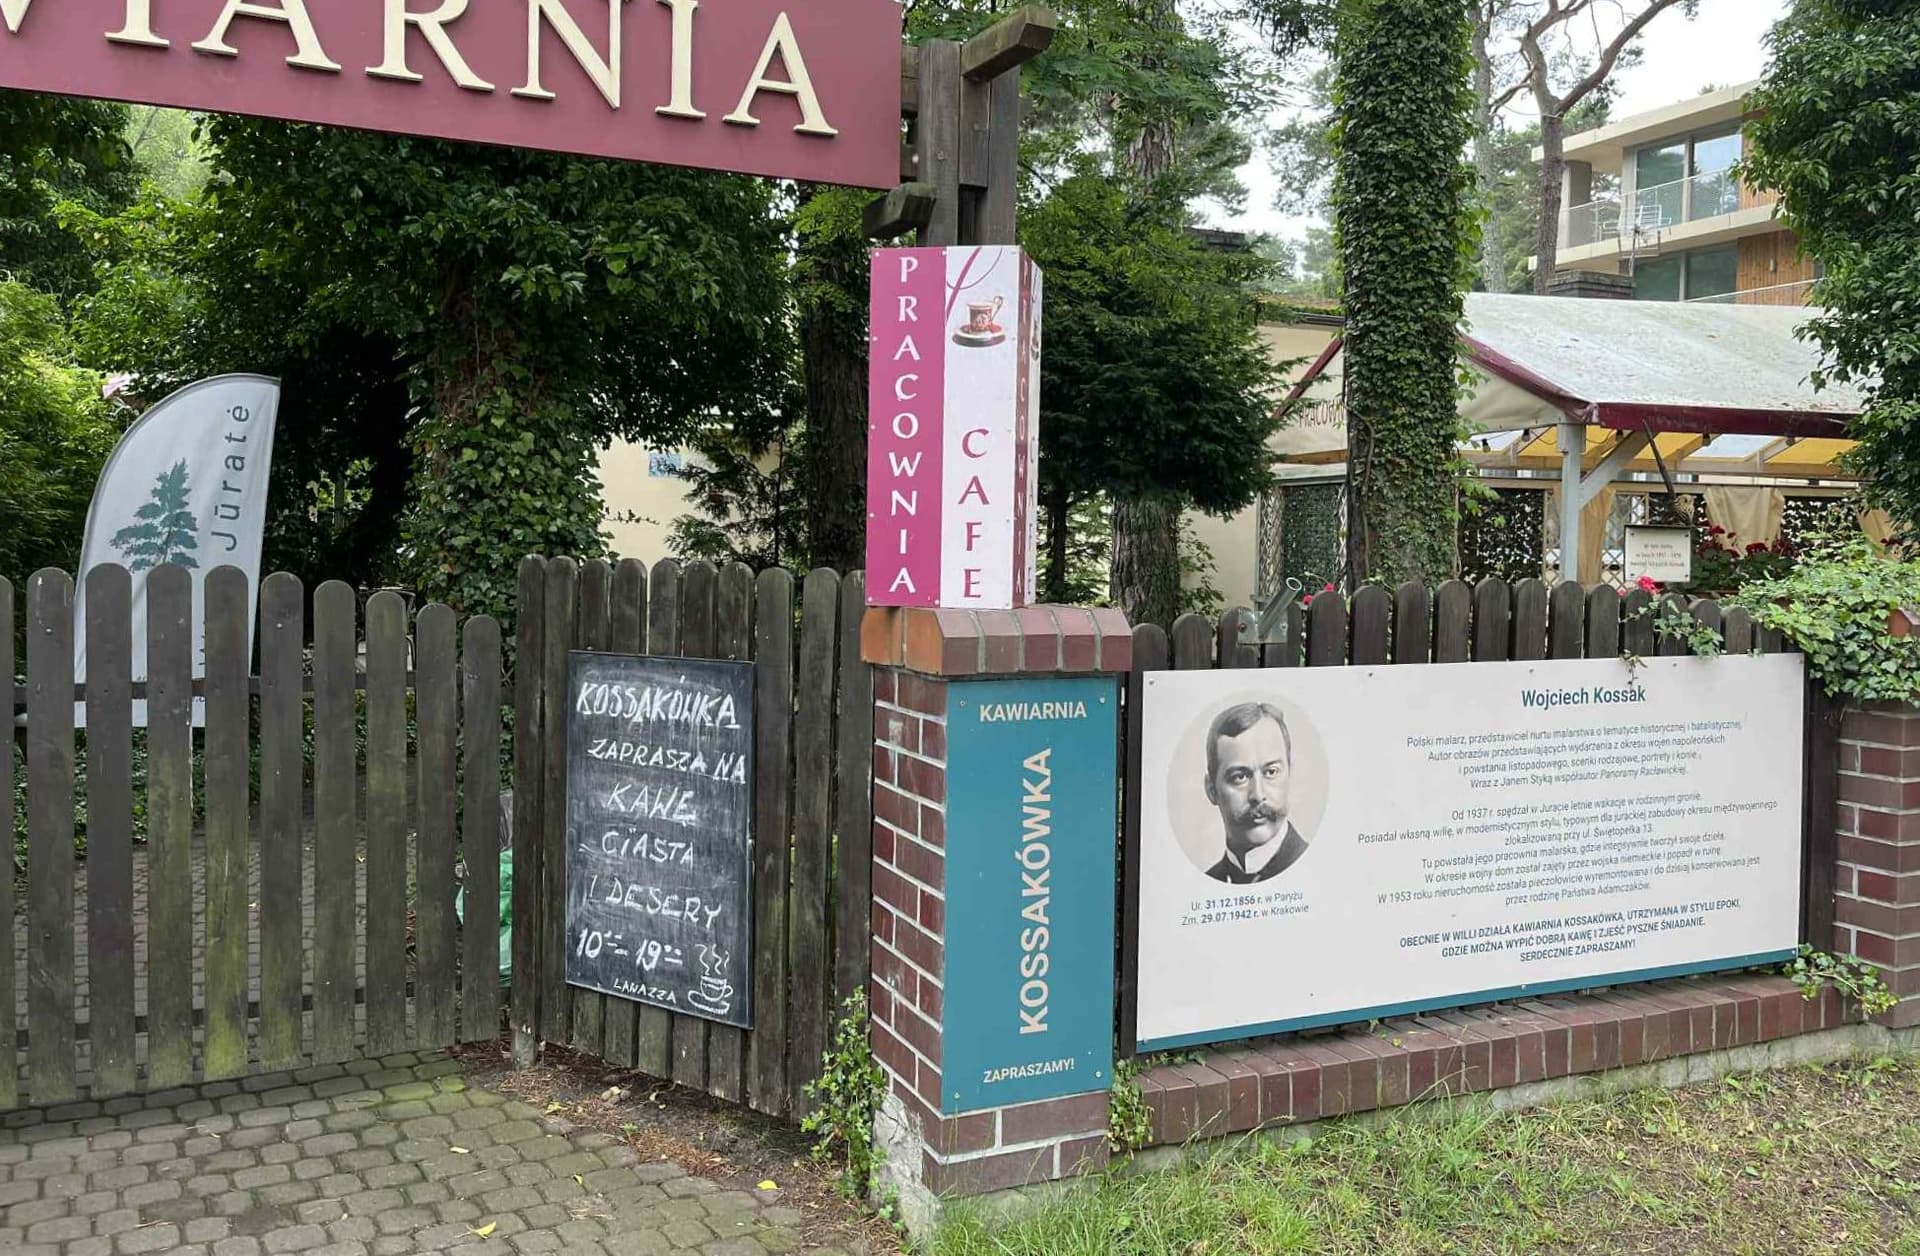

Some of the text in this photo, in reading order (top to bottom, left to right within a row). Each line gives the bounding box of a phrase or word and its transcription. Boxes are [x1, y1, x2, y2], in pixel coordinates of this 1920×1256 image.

[0, 0, 838, 137] ARNIA
[888, 256, 922, 594] PRACOWNIA
[211, 404, 250, 551] Jūratė
[957, 428, 990, 599] CAFE
[979, 700, 1087, 722] KAWIARNIA
[1521, 685, 1646, 711] Wojciech Kossak
[1407, 736, 1433, 747] Polski
[1468, 731, 1528, 746] przedstawiciel
[1530, 730, 1552, 740] nurtu
[1554, 728, 1595, 739] malarstwa
[1603, 726, 1639, 737] tematyce
[1641, 722, 1685, 735] historycznej
[1428, 751, 1452, 761] Autor
[1454, 748, 1489, 759] obrazów
[1491, 743, 1567, 759] przedstawiających
[1568, 741, 1614, 754] wydarzenia
[1620, 740, 1646, 749] okresu
[1648, 738, 1670, 749] wojen
[1672, 734, 1725, 748] napoleońskich
[588, 738, 746, 785] ZAPRASZA NA
[1463, 762, 1506, 776] powstania
[1570, 756, 1597, 766] scenki
[1641, 752, 1670, 764] portrety
[1470, 778, 1491, 788] Wraz
[1493, 779, 1498, 787] z
[1500, 777, 1528, 786] Janem
[1530, 774, 1552, 786] Styką
[1554, 771, 1598, 784] współautor
[1599, 770, 1638, 779] Panoramy
[606, 783, 697, 827] KAWĘ
[1451, 810, 1464, 820] Od
[1467, 808, 1488, 819] 1937
[1496, 805, 1528, 818] spędzał
[1530, 806, 1538, 814] w
[1539, 802, 1569, 813] Juracie
[1570, 800, 1593, 810] letnie
[1594, 798, 1626, 809] wakacje
[1628, 798, 1634, 806] w
[1635, 795, 1675, 805] rodzinnym
[1357, 831, 1397, 844] Posiadał
[1399, 830, 1430, 840] własną
[1456, 827, 1464, 835] w
[1465, 821, 1538, 834] modernistycznym
[1562, 816, 1598, 828] typowym
[1600, 813, 1612, 822] dla
[1613, 810, 1646, 824] jurackiej
[1647, 808, 1685, 818] zabudowy
[1687, 805, 1712, 815] okresu
[1505, 833, 1561, 845] zlokalizowaną
[1563, 831, 1580, 842] przy
[1582, 829, 1591, 838] ul.
[1593, 824, 1640, 838] Świętopełka
[1422, 858, 1432, 868] Tu
[1434, 854, 1474, 869] powstała
[1475, 853, 1493, 865] jego
[1495, 848, 1537, 863] pracownia
[1579, 843, 1601, 856] gdzie
[1649, 835, 1678, 847] tworzył
[1679, 834, 1702, 845] swoje
[1424, 873, 1434, 883] W
[1435, 870, 1466, 882] okresie
[1468, 868, 1492, 880] wojny
[1494, 867, 1513, 876] dom
[1515, 863, 1540, 874] został
[1542, 861, 1565, 873] zajęty
[1567, 860, 1589, 872] przez
[1591, 856, 1618, 868] wojska
[1620, 852, 1661, 864] niemieckie
[1667, 848, 1693, 861] popadł
[1015, 748, 1052, 1035] KOSSAKÓWKA
[1377, 893, 1387, 904] W
[1390, 891, 1410, 902] 1953
[1413, 889, 1432, 900] roku
[1434, 882, 1494, 898] nieruchomość
[1496, 879, 1527, 891] została
[1585, 868, 1648, 884] wyremontowana
[1654, 865, 1664, 875] do
[1666, 862, 1690, 874] dzisiaj
[1691, 859, 1745, 871] konserwowana
[1746, 855, 1760, 867] jest
[1505, 894, 1528, 907] przez
[1529, 890, 1559, 901] rodzinę
[1561, 887, 1596, 898] Państwa
[605, 876, 722, 929] DESERY
[1181, 916, 1197, 926] Zm.
[1201, 909, 1251, 924] 29.07.1942
[1261, 909, 1269, 917] w
[1270, 903, 1309, 916] Krakowie
[1191, 901, 1202, 911] Ur.
[1204, 895, 1255, 910] 31.12.1856
[1265, 895, 1273, 903] w
[1274, 890, 1303, 903] Paryżu
[1400, 933, 1438, 947] OBECNIE
[1441, 931, 1450, 942] W
[1452, 928, 1477, 941] WILLI
[1478, 924, 1511, 938] DZIAŁA
[1512, 918, 1562, 934] KAWIARNIA
[1627, 905, 1679, 920] UTRZYMANA
[1680, 904, 1688, 914] W
[1690, 901, 1715, 913] STYLU
[1441, 944, 1469, 957] GDZIE
[1470, 939, 1504, 954] MOŻNA
[1505, 934, 1534, 949] WYPIĆ
[1535, 932, 1566, 946] DOBRĄ
[1567, 929, 1592, 942] KAWĘ
[1598, 923, 1625, 938] ZJEŚĆ
[1626, 921, 1659, 934] PYSZNE
[1660, 916, 1705, 930] ŚNIADANIE.
[1520, 938, 1636, 962] SERDECZNIE ZAPRASZAMY!
[983, 1057, 1075, 1083] ZAPRASZAMY!
